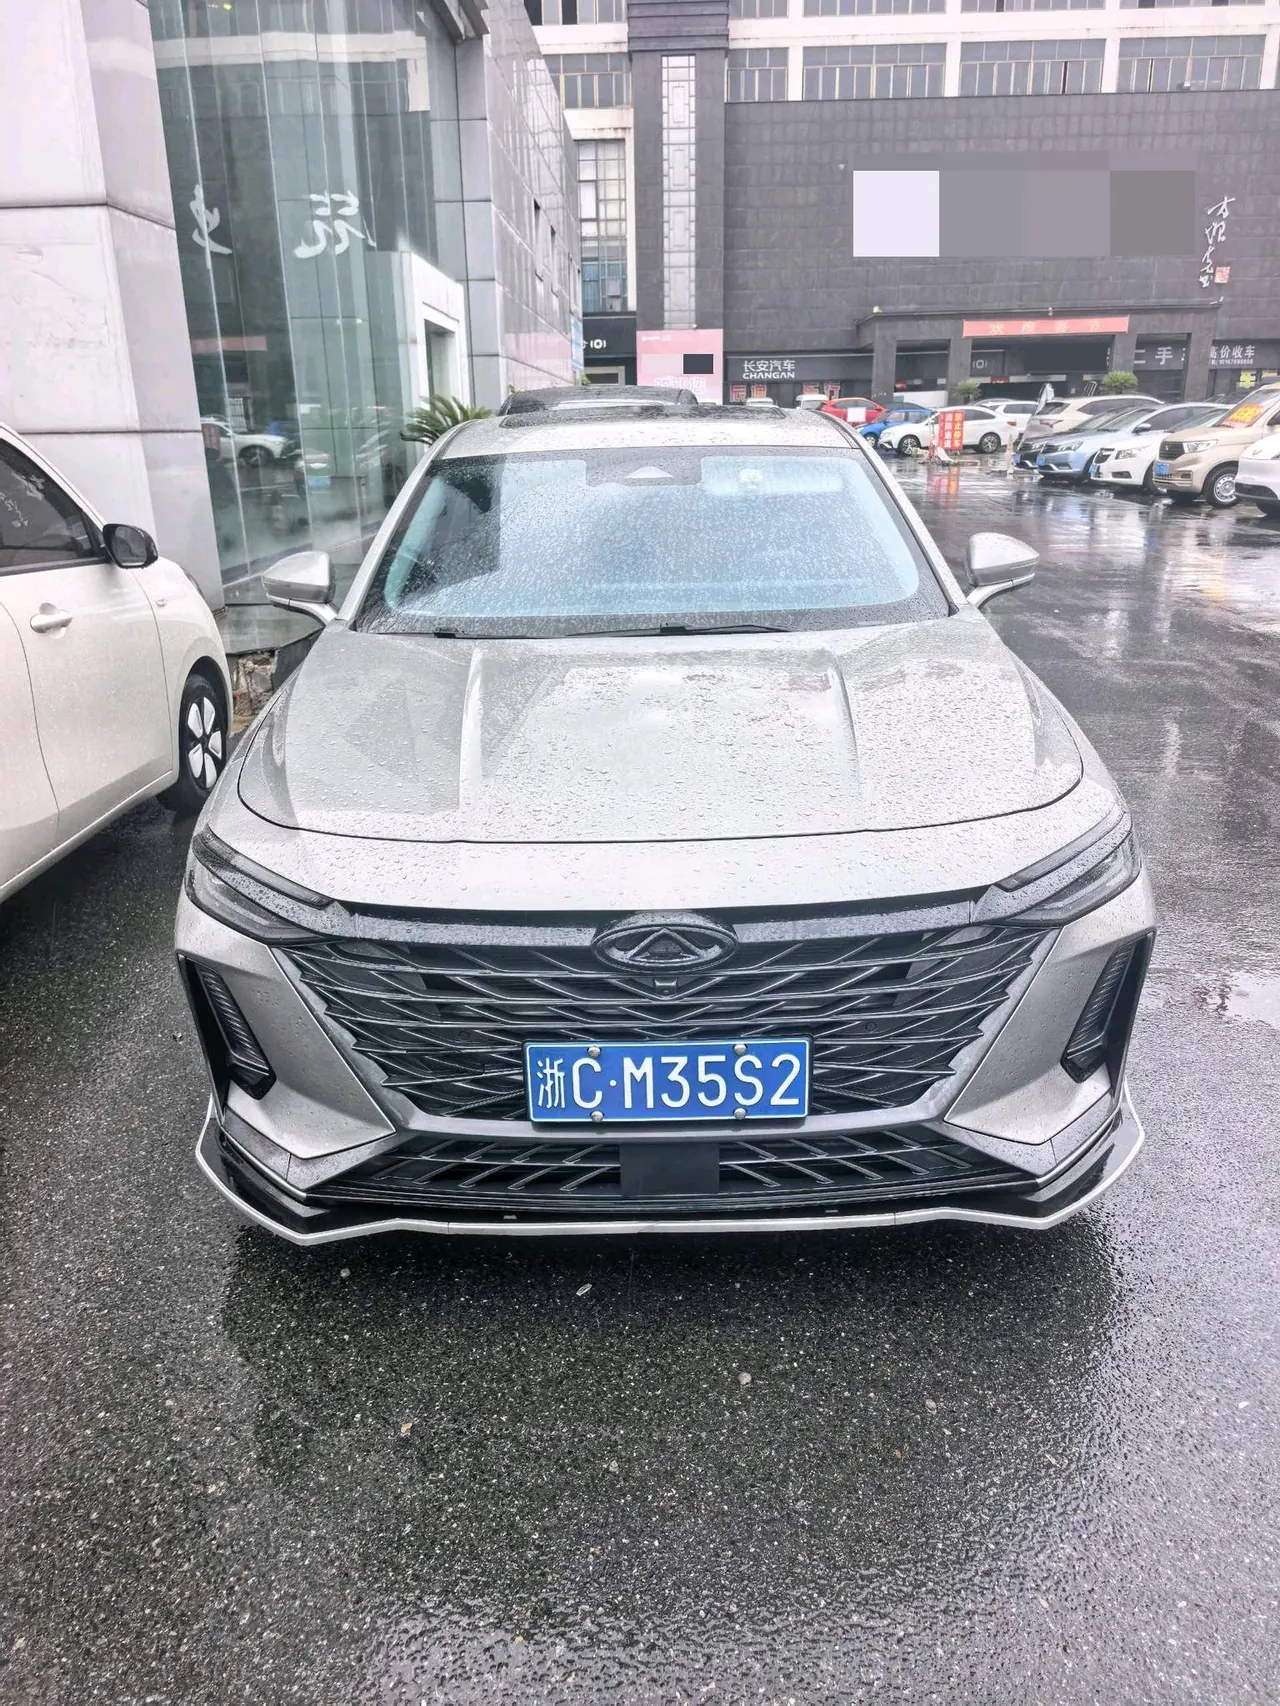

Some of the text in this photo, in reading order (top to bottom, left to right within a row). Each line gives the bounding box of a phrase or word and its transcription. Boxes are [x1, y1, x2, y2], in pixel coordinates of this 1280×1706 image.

[743, 360, 796, 372] 长安汽车
[742, 371, 795, 379] CHANGAN
